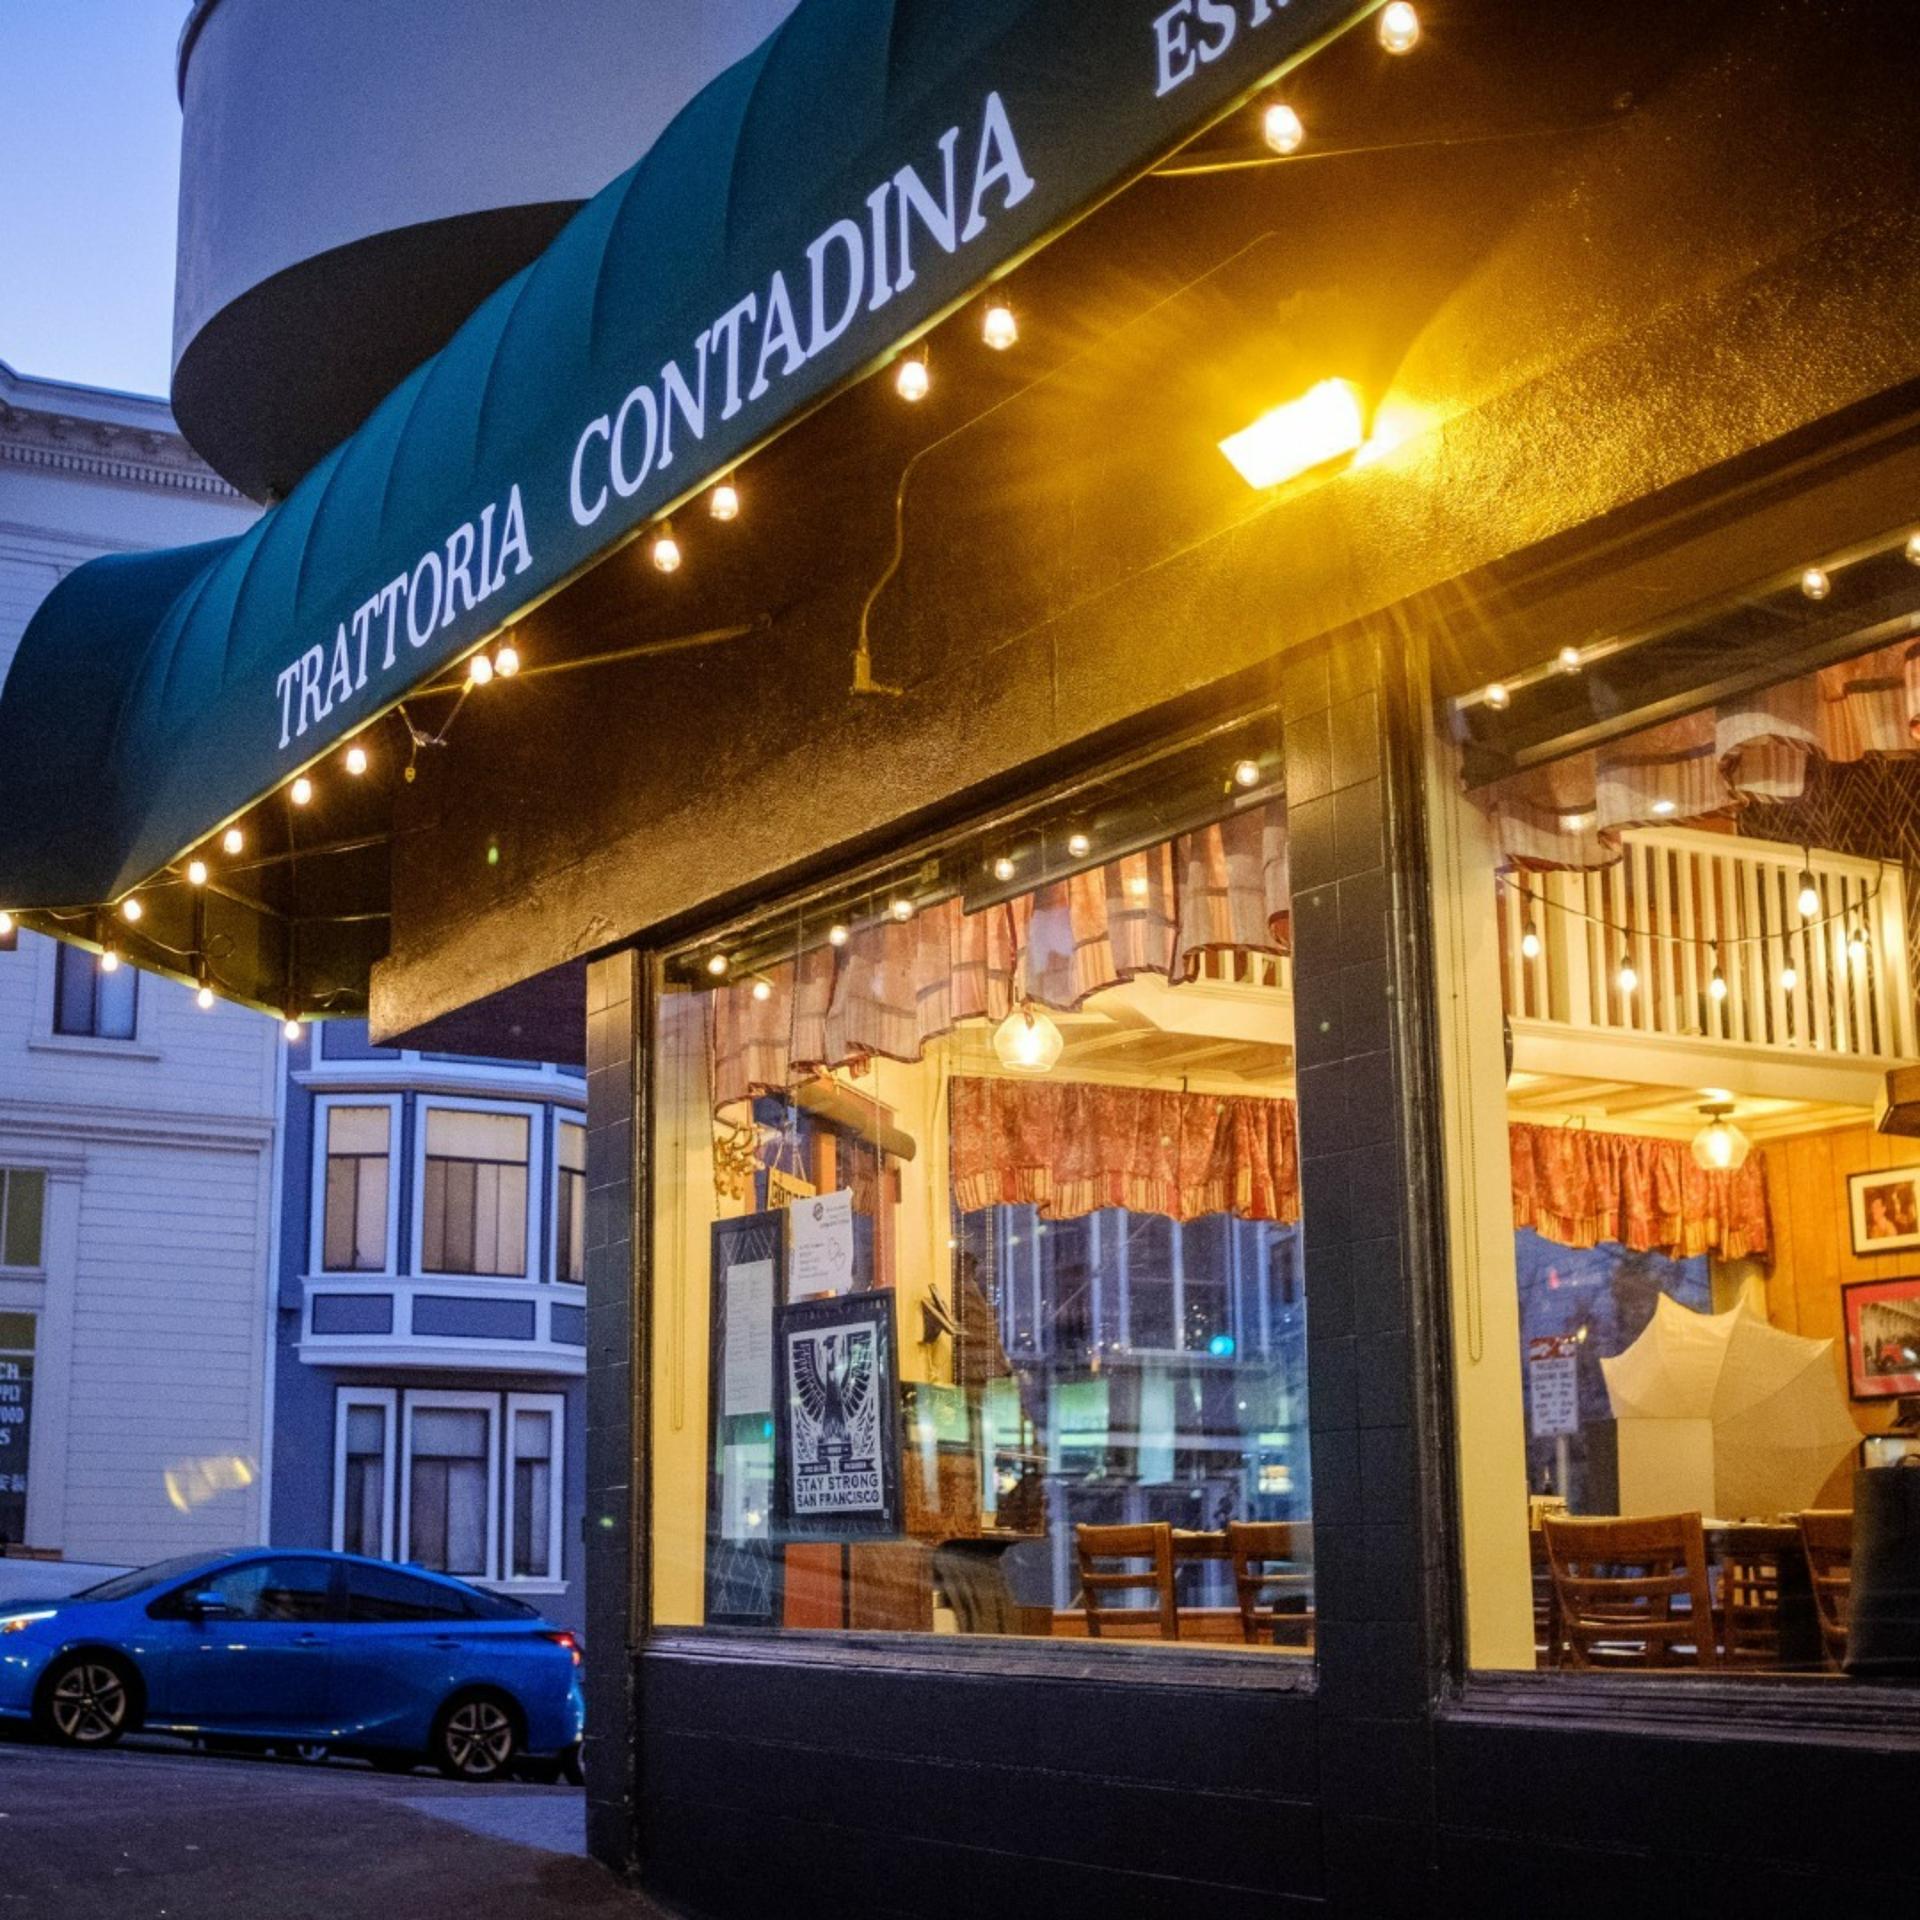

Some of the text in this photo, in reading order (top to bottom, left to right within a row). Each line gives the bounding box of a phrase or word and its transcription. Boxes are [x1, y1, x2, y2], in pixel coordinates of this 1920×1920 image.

[276, 483, 533, 749] TRATTORIA
[570, 91, 1035, 526] CONTADINA
[796, 1473, 879, 1493] STAY STRONG
[797, 1489, 880, 1508] SAN FRANCISCO
